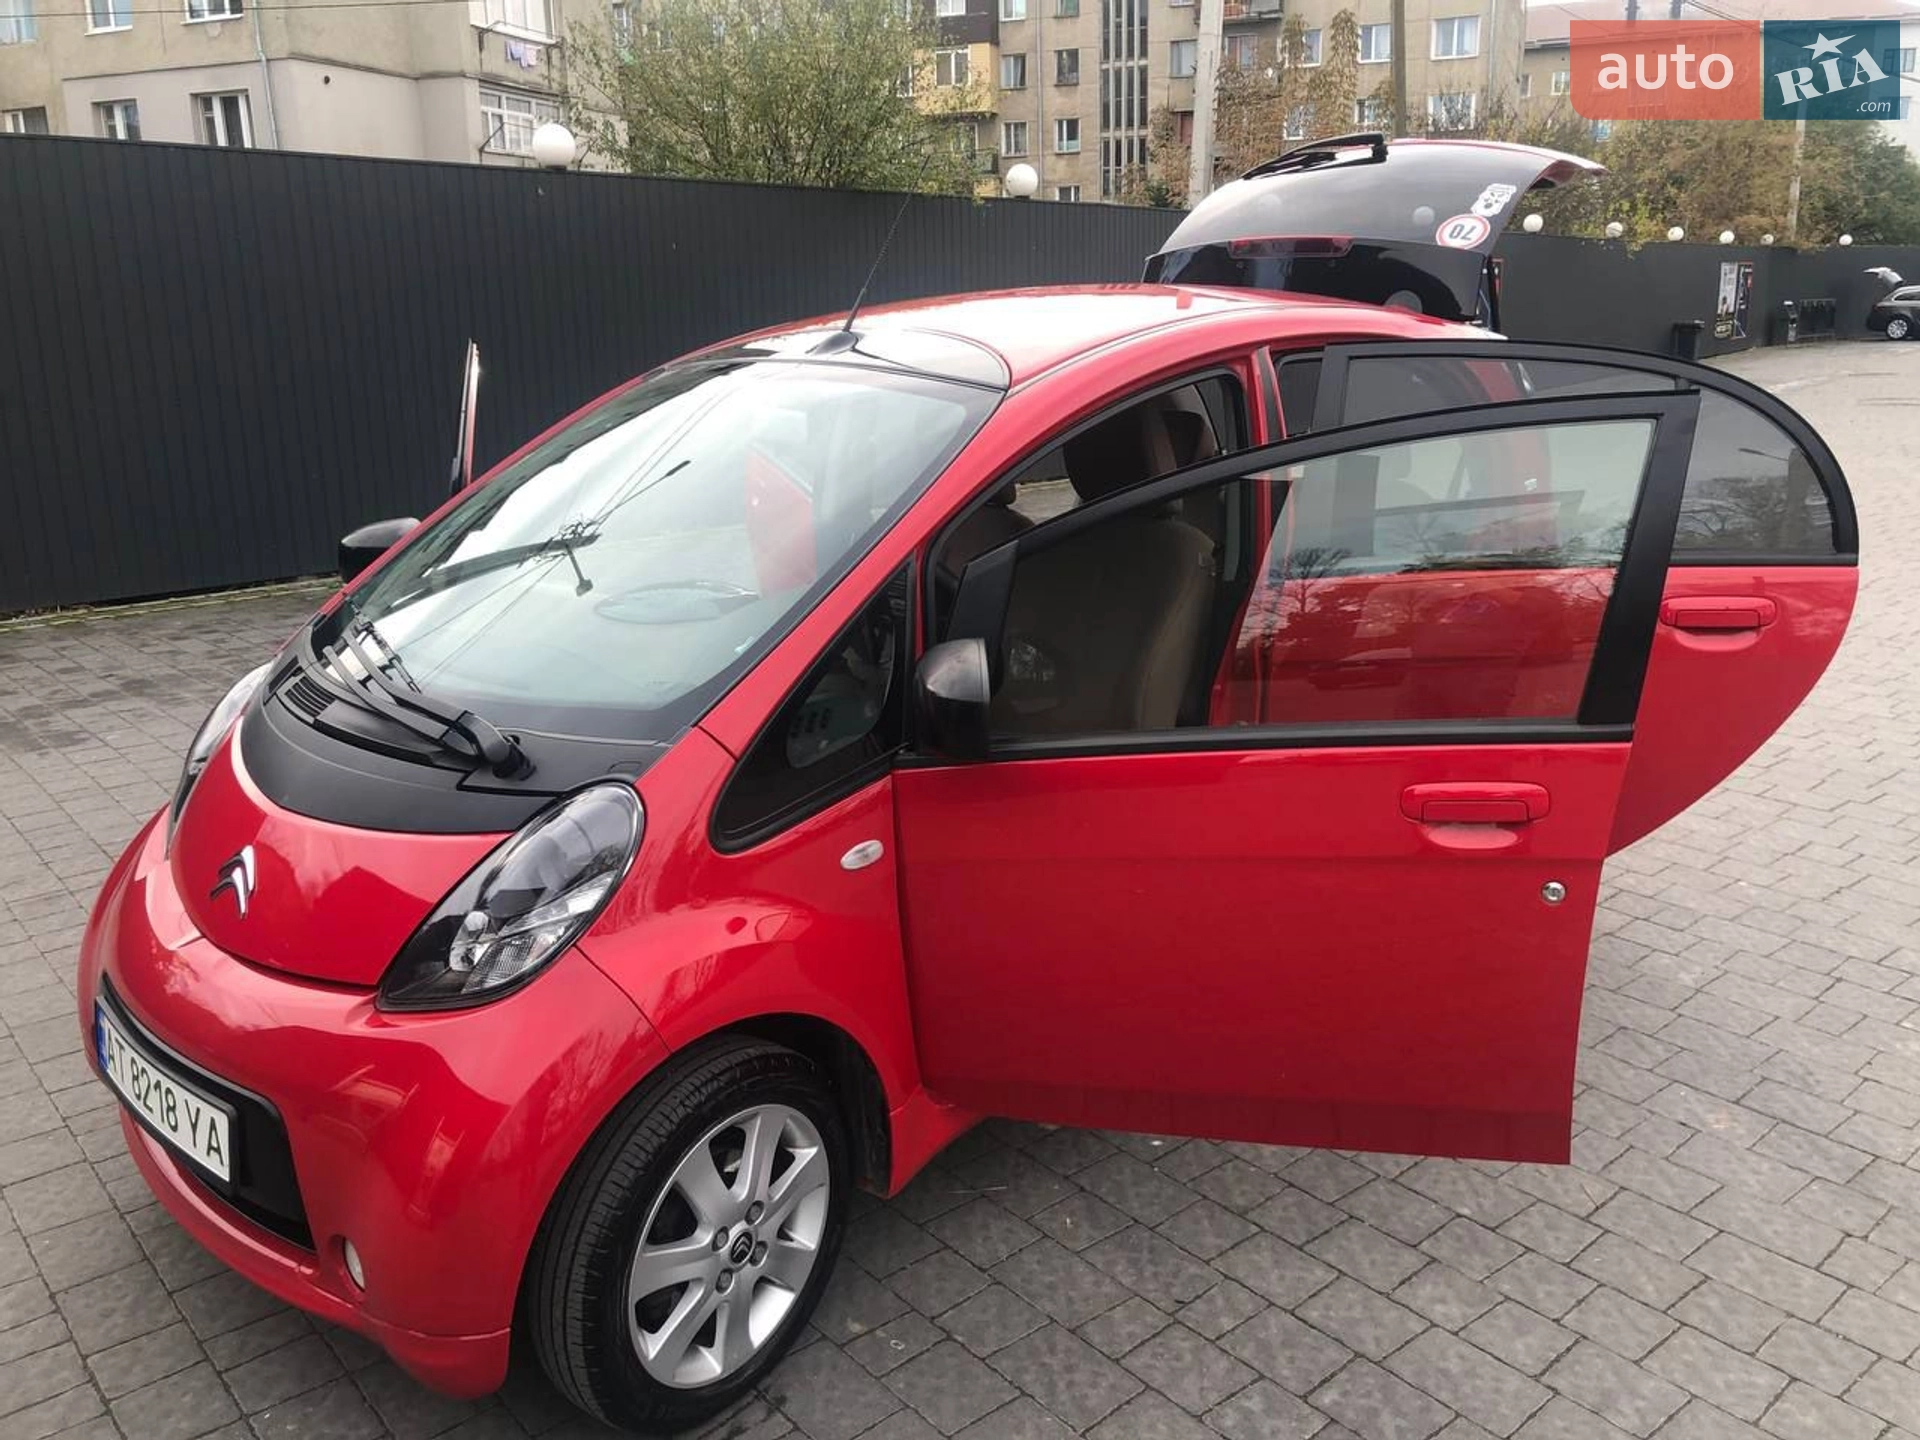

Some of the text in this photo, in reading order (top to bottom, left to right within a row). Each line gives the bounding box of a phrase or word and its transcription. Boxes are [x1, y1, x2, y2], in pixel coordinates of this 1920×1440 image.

[1449, 224, 1476, 240] 70
[108, 1028, 225, 1166] AT 8218 YA
